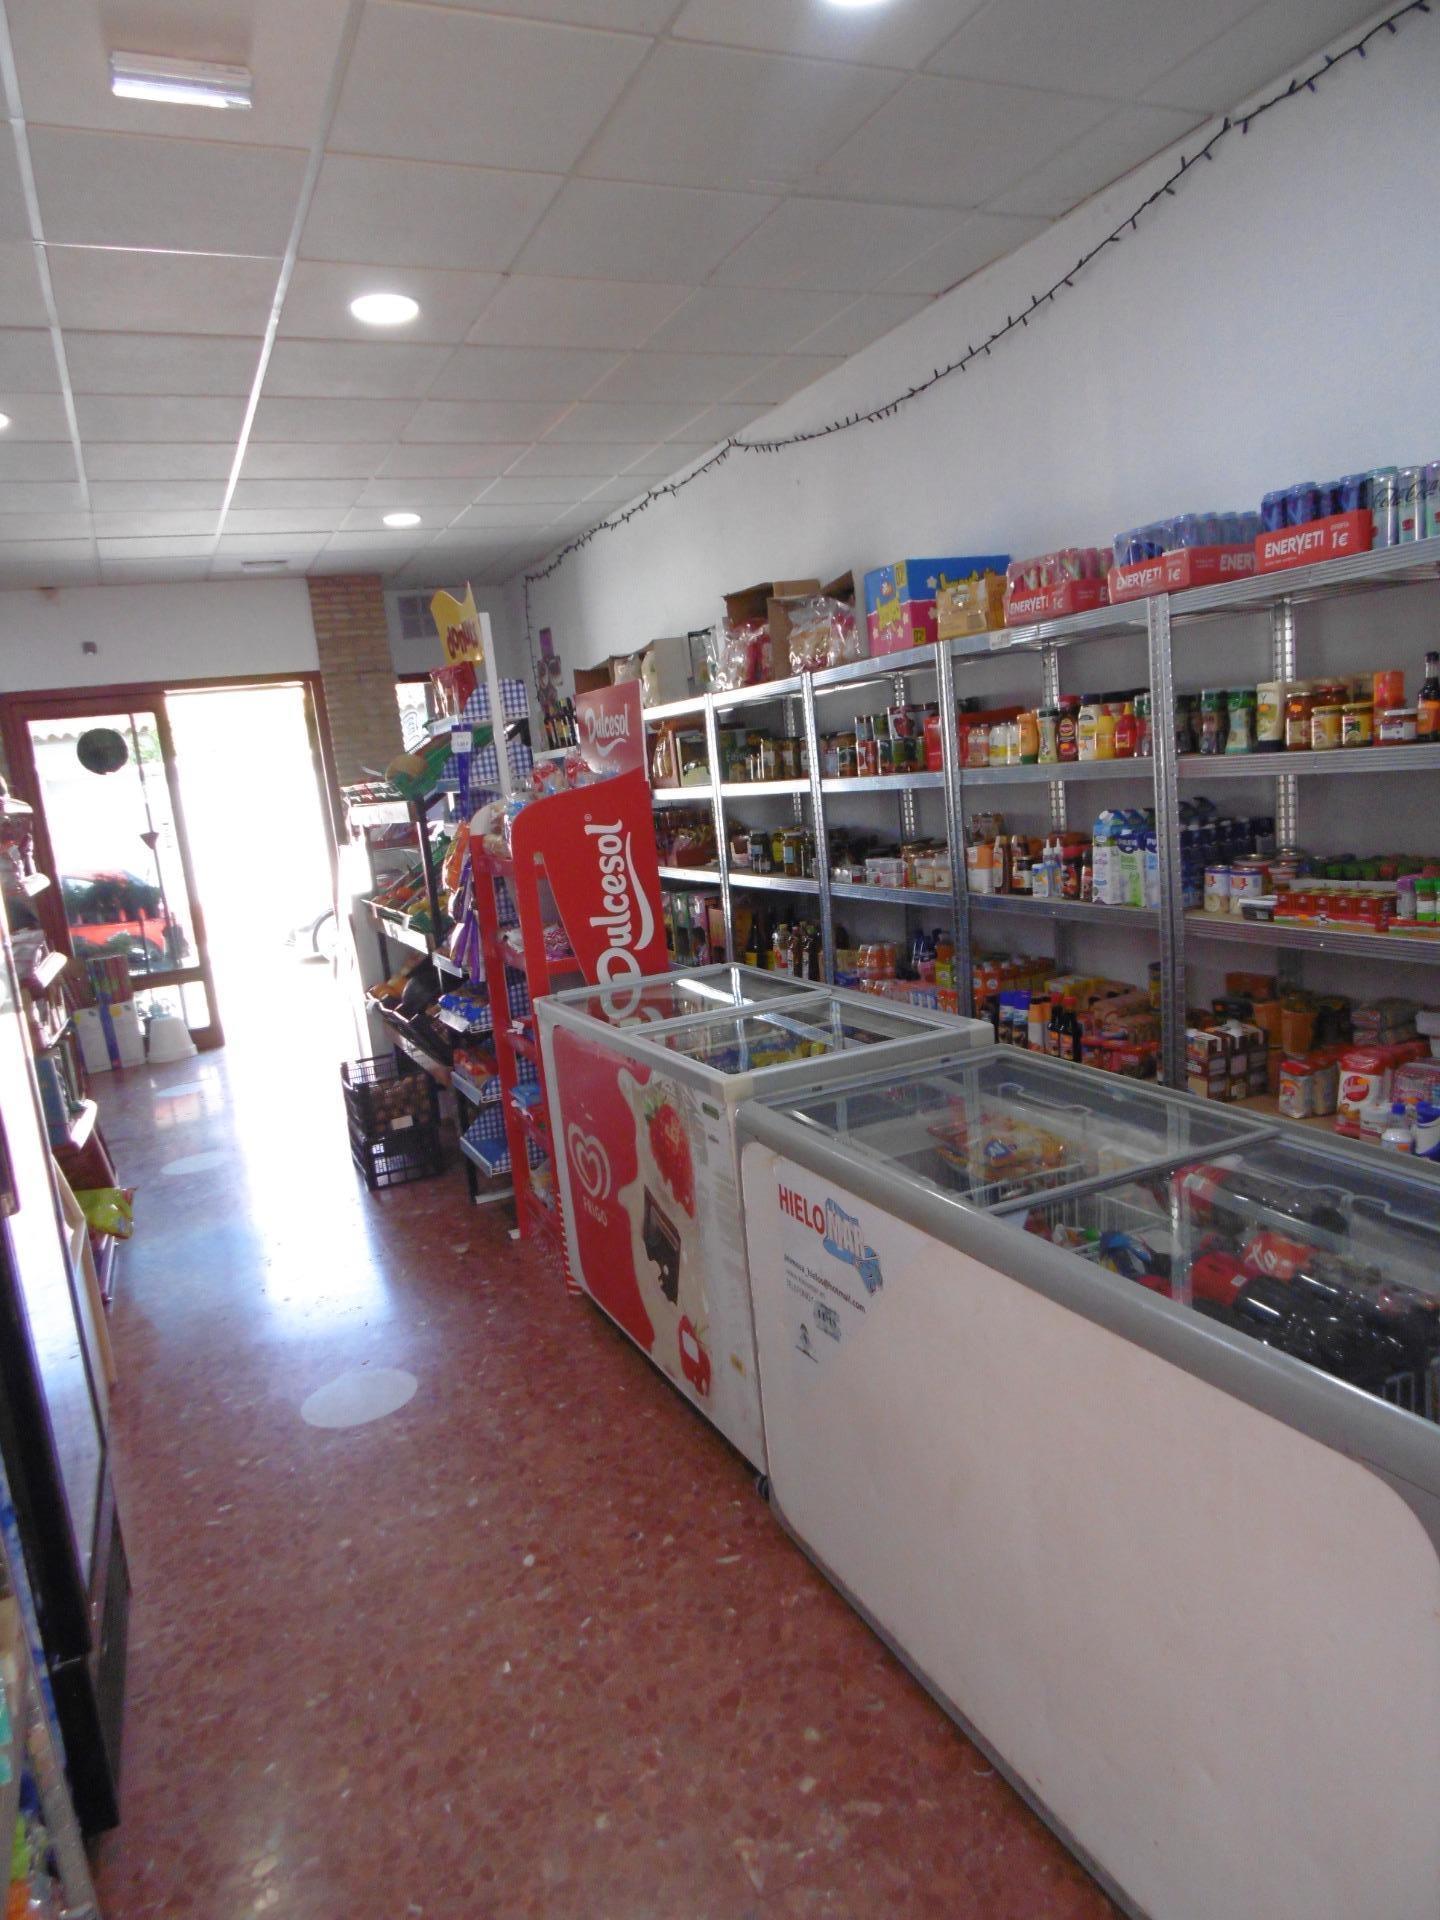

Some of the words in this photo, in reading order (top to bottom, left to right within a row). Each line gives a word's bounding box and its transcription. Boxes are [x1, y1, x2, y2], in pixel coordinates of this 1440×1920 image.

[1264, 530, 1324, 559] ENERYETI
[1331, 531, 1349, 549] 1€
[584, 703, 630, 744] Dulcesol
[584, 819, 643, 1020] Dulcesol
[778, 1183, 825, 1235] HIELO
